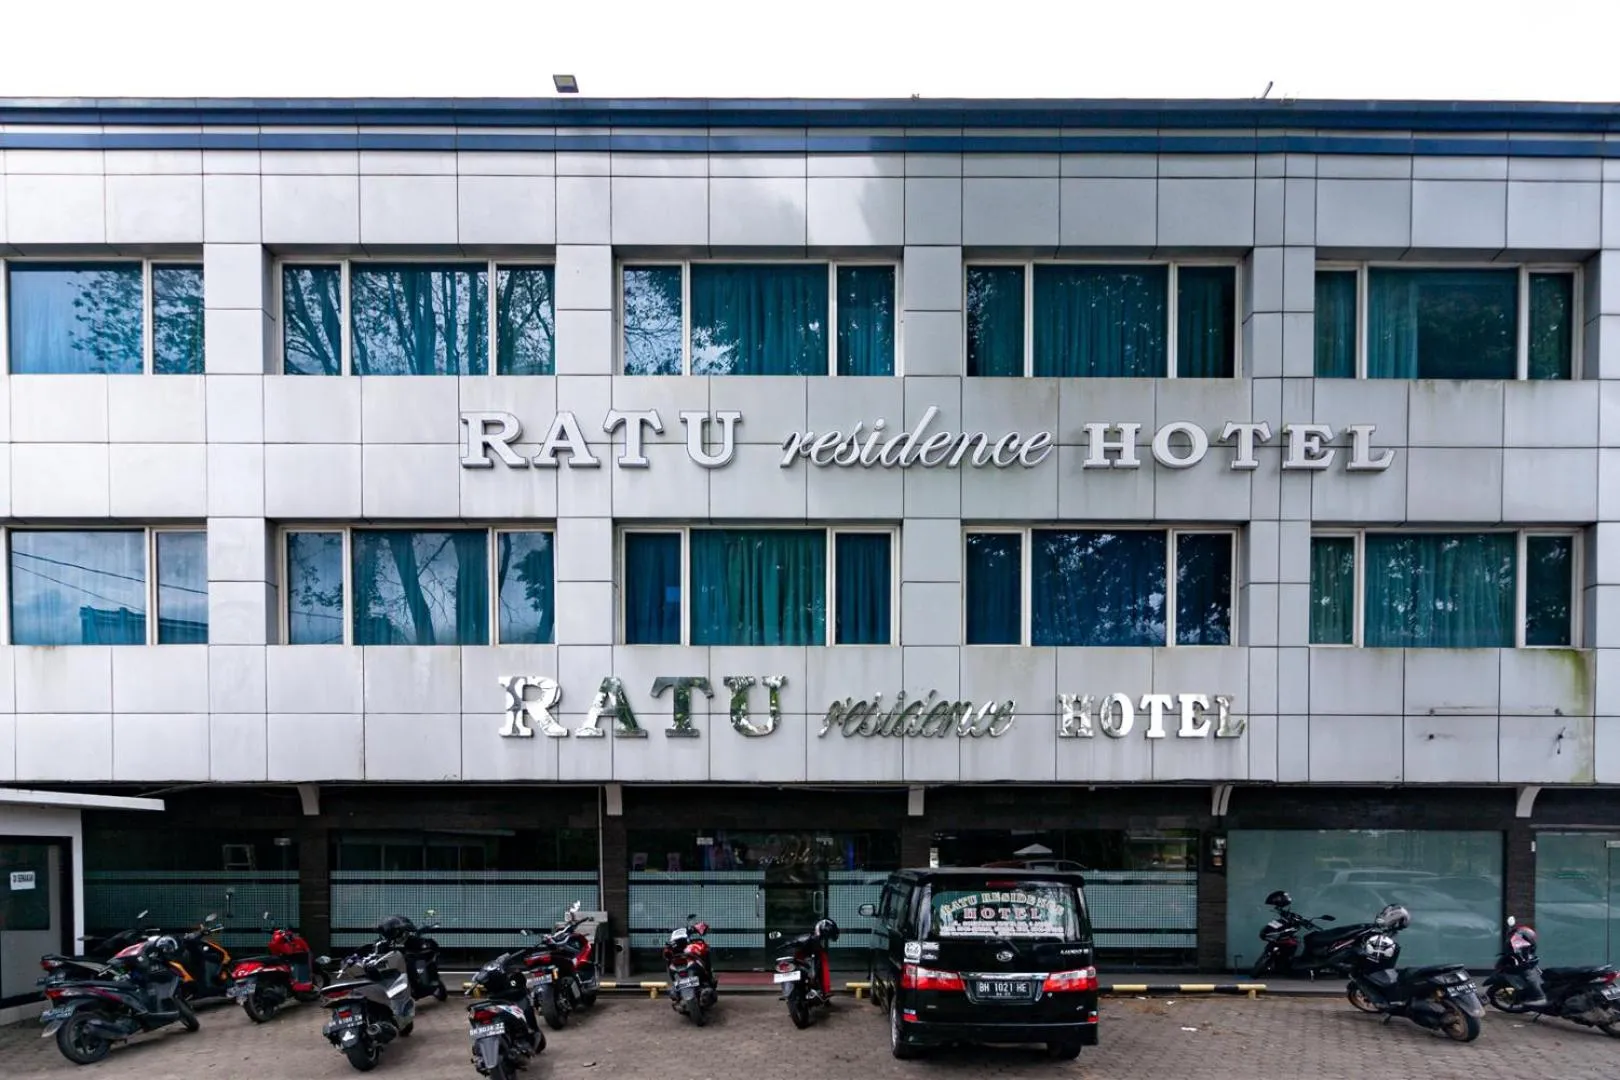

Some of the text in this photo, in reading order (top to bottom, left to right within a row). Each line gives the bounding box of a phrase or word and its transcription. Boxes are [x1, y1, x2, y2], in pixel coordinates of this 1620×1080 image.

[460, 405, 1397, 472] RATU residence HOTEL
[498, 675, 1248, 740] RATU residence HOTEL
[963, 907, 1041, 920] HOTEL
[980, 982, 1027, 992] BH 1021 HE
